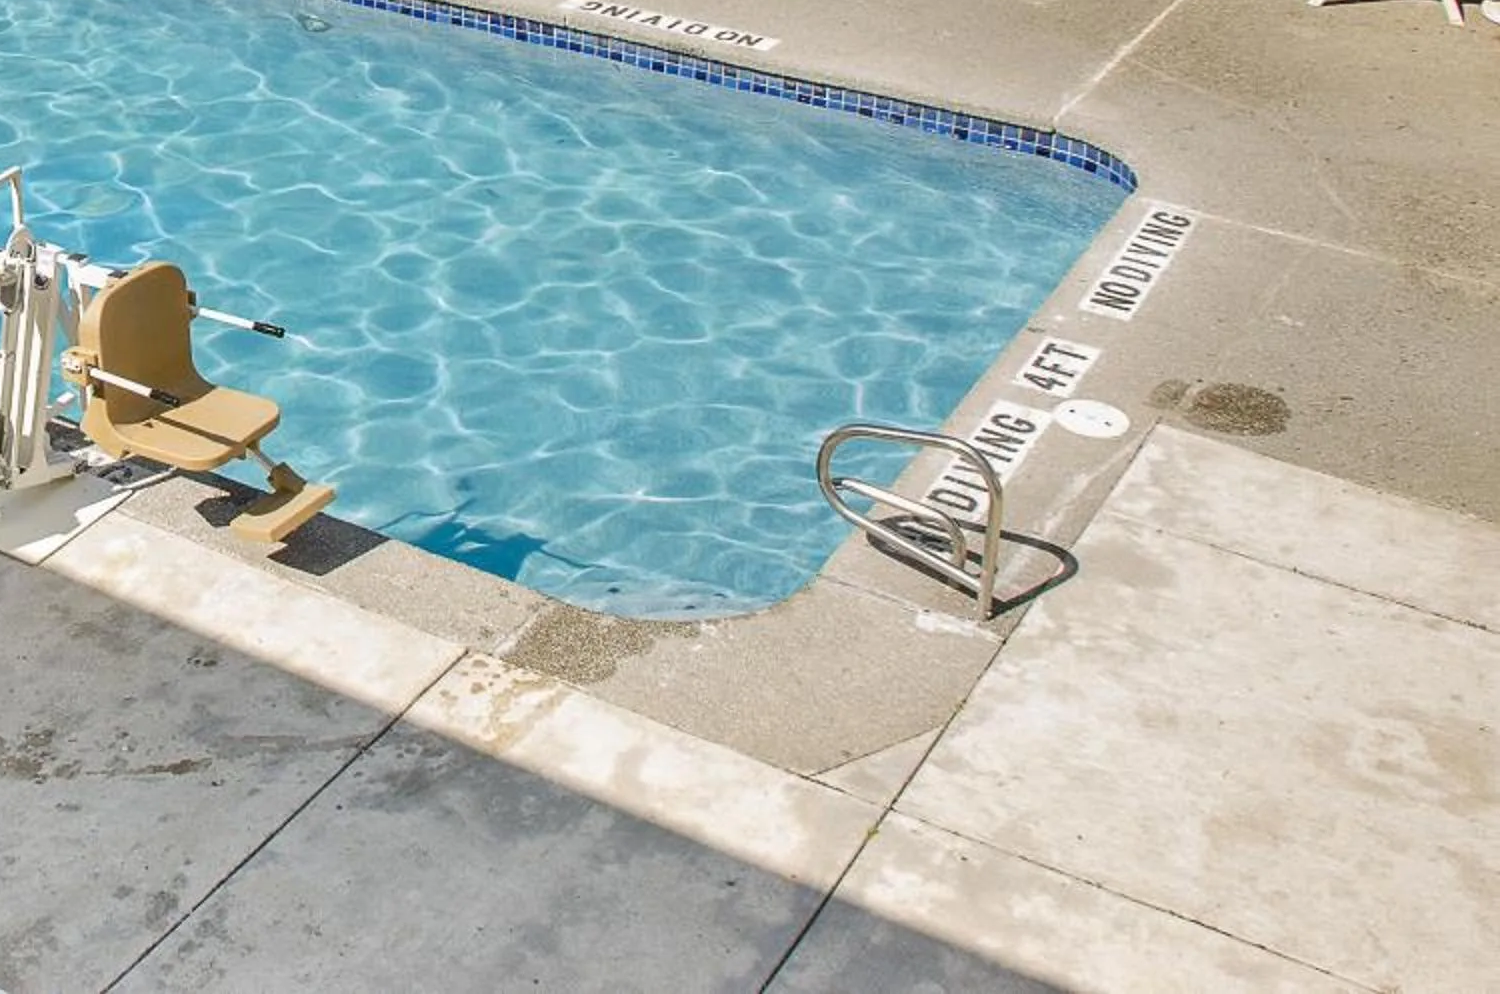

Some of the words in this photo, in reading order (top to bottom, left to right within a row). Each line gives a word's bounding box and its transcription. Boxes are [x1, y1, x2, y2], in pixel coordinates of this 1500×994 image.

[579, 0, 709, 36] DIVING
[713, 29, 764, 47] NO
[1109, 211, 1191, 283] DIVING
[1089, 281, 1141, 312] NO
